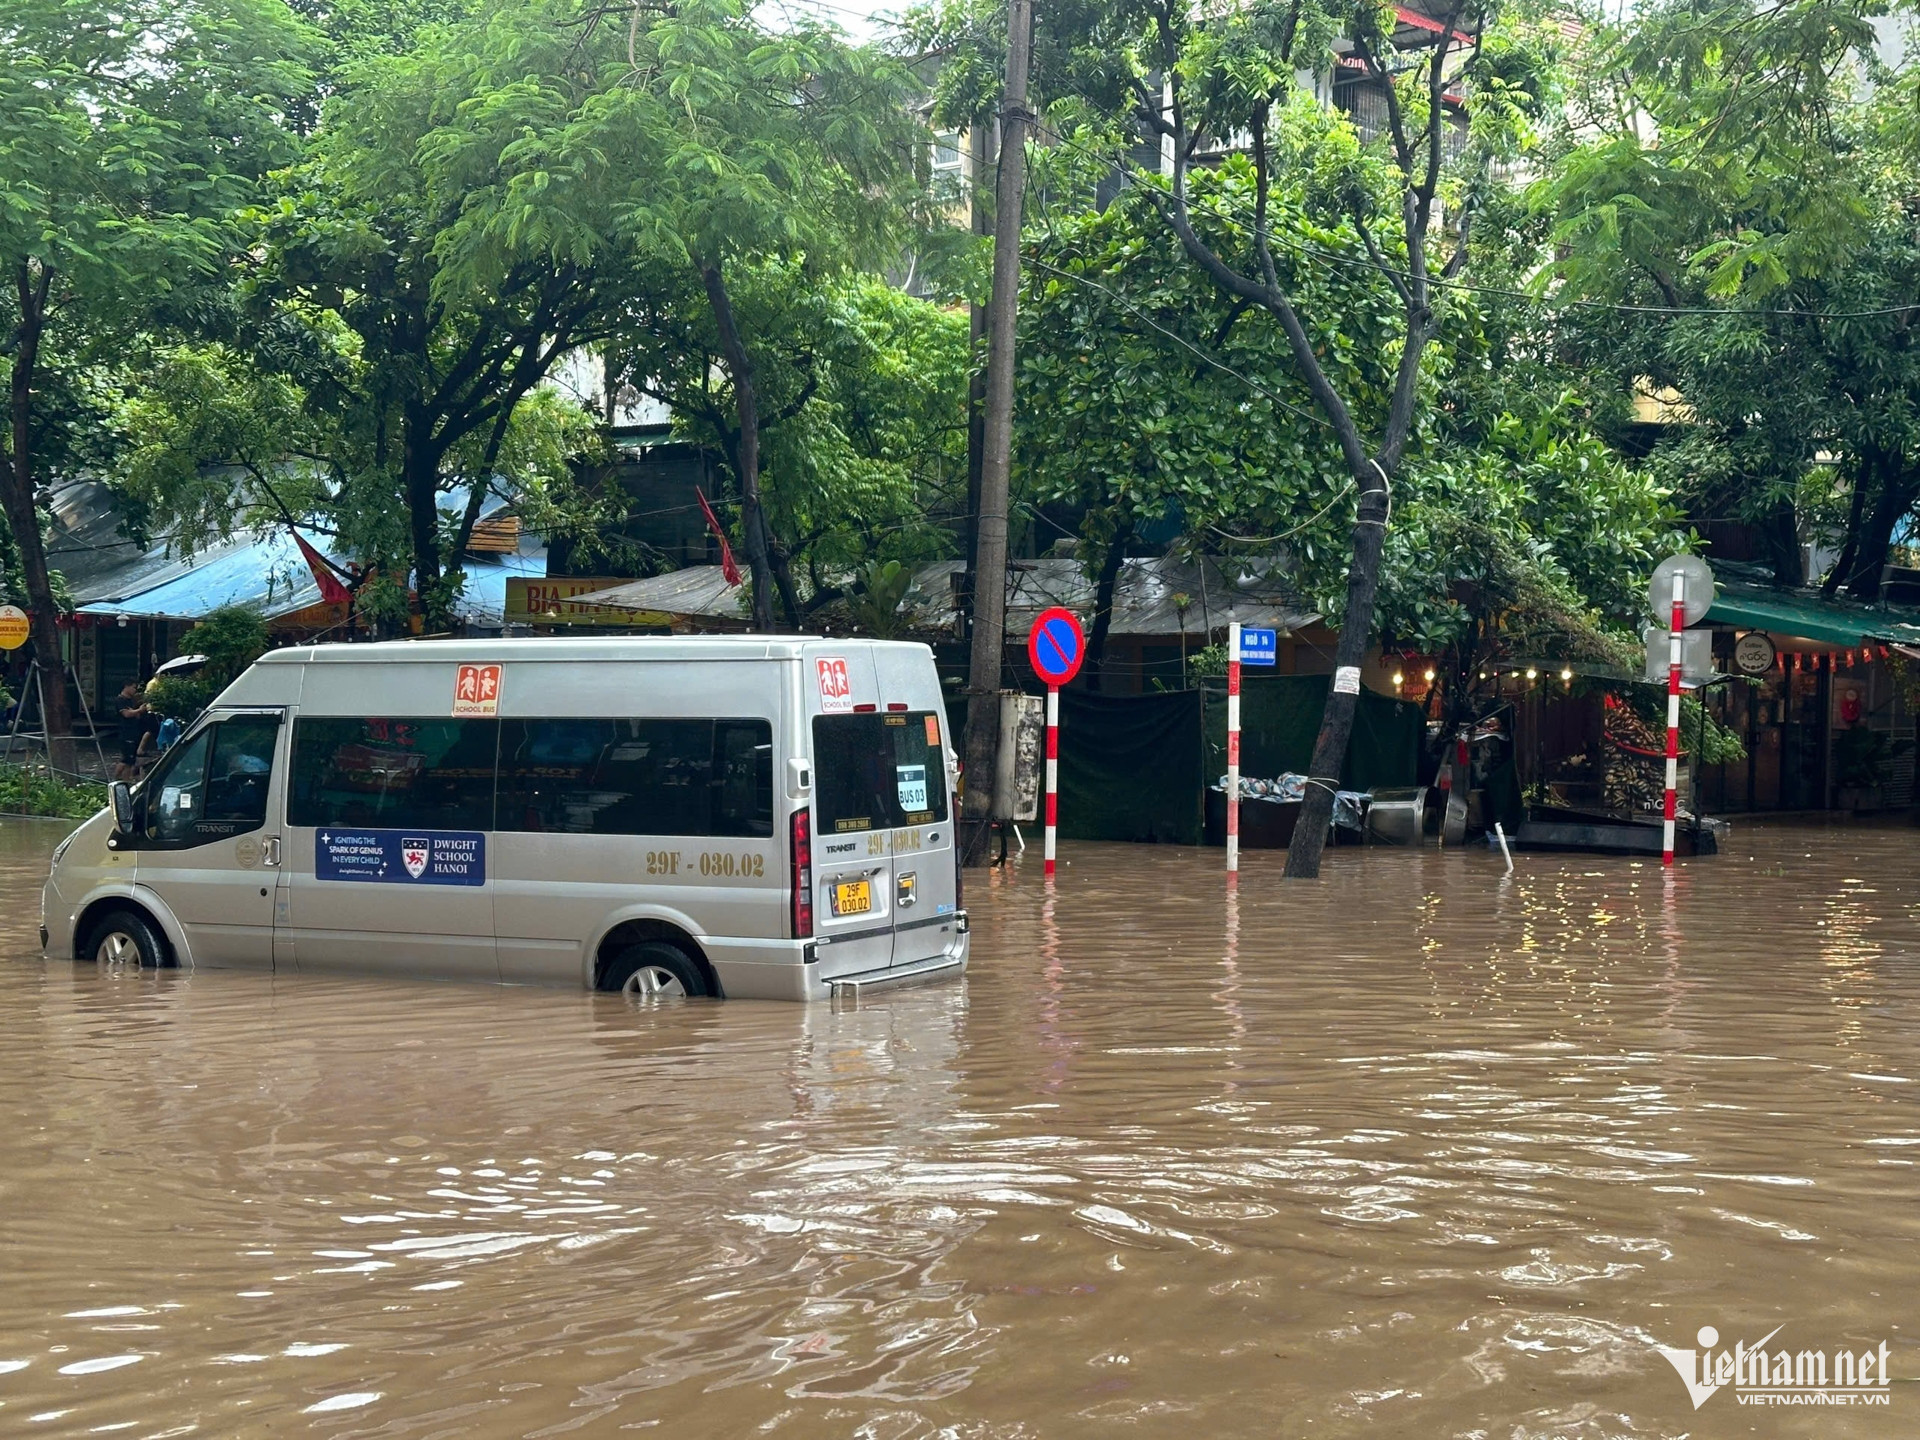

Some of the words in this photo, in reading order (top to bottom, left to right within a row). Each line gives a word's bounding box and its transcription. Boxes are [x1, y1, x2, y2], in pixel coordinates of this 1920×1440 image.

[527, 586, 562, 613] BIA
[823, 700, 842, 709] SCHOOL
[843, 700, 852, 708] BUS
[900, 789, 915, 803] BUS
[914, 788, 925, 802] 03
[195, 825, 236, 833] TRANSIT
[335, 836, 363, 845] IGNITING
[363, 837, 376, 845] THE
[434, 839, 478, 850] DWIGHT
[867, 833, 884, 855] 29F
[329, 846, 349, 854] SPARK
[360, 847, 384, 855] GENIUS
[826, 843, 857, 854] TRANSIT
[341, 856, 360, 864] EVERY
[360, 856, 380, 864] CHILD
[434, 852, 476, 862] SCHOOL
[434, 864, 468, 874] HANOI
[646, 851, 681, 875] 29F
[699, 852, 765, 878] 030.02
[846, 883, 861, 898] 29F
[841, 897, 868, 912] 030.02
